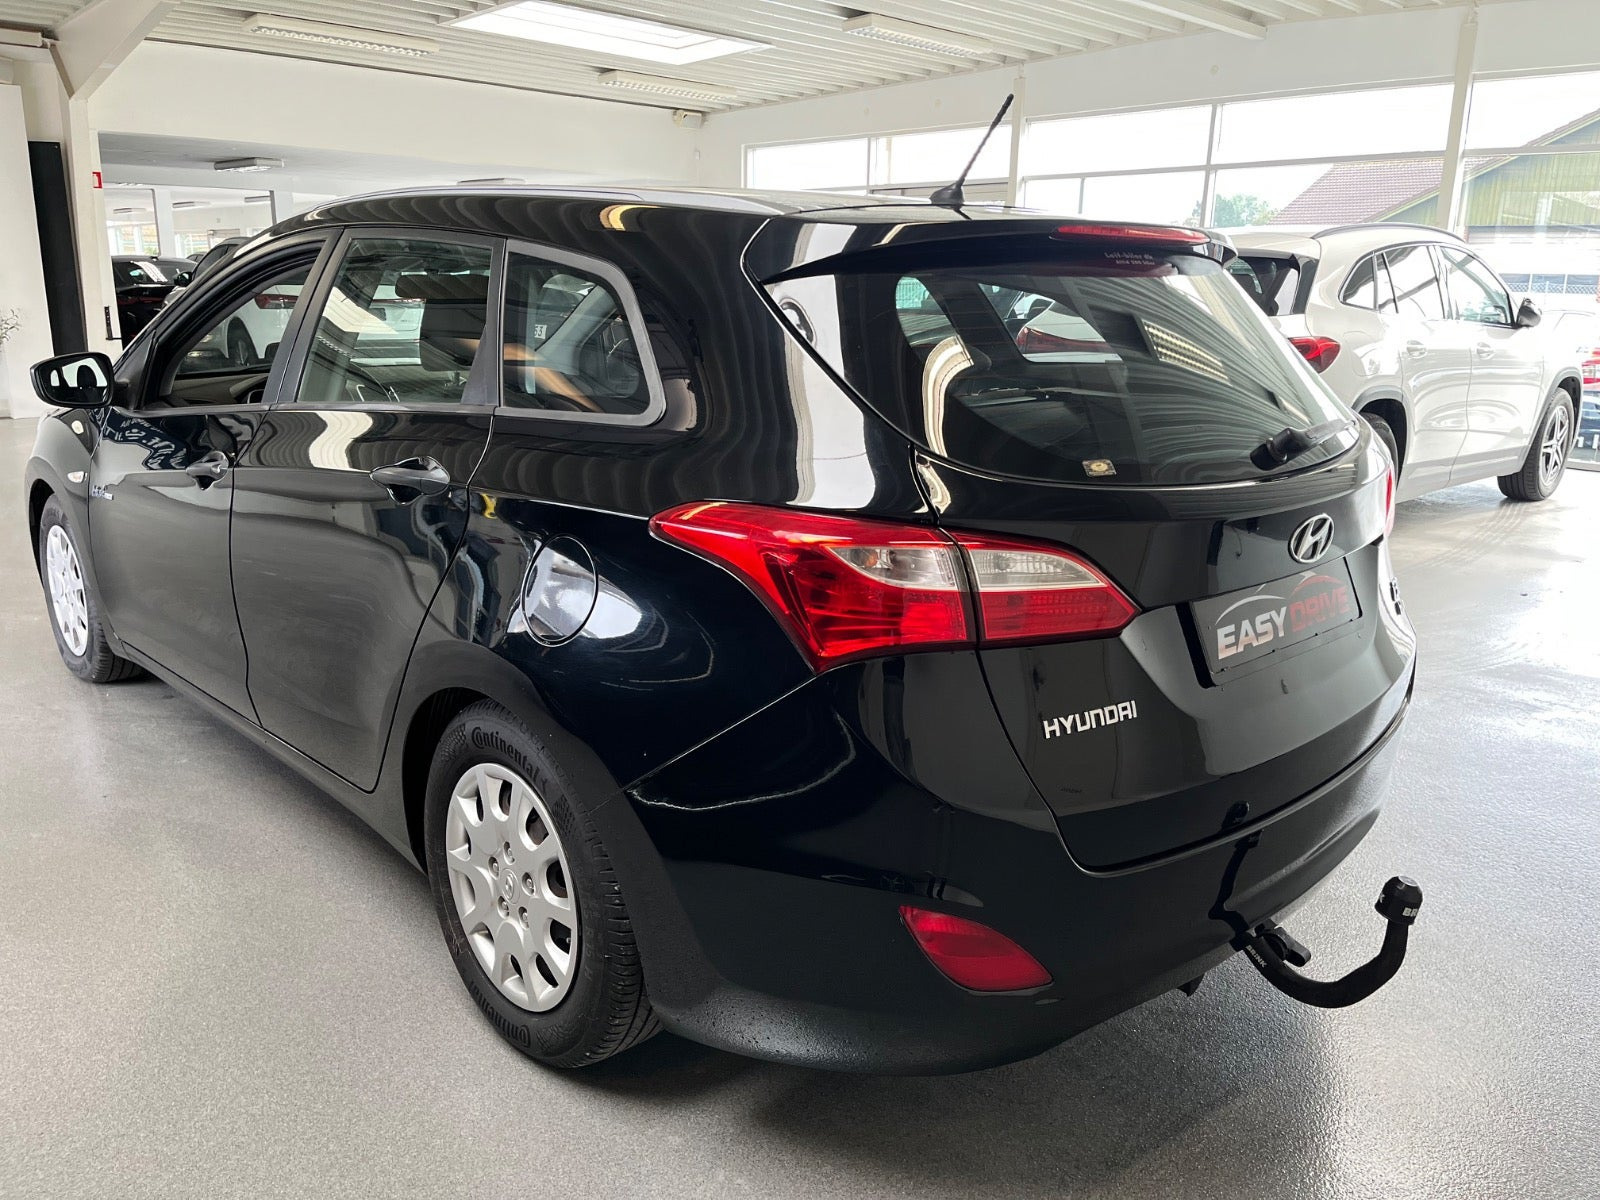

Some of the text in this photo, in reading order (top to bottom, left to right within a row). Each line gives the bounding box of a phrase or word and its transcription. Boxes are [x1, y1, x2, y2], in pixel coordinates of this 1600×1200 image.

[1216, 606, 1287, 660] EASY
[1289, 585, 1350, 633] DRIVE
[1043, 700, 1137, 739] HYUNDAI
[471, 726, 540, 780] Continental
[1245, 944, 1268, 968] BRINK
